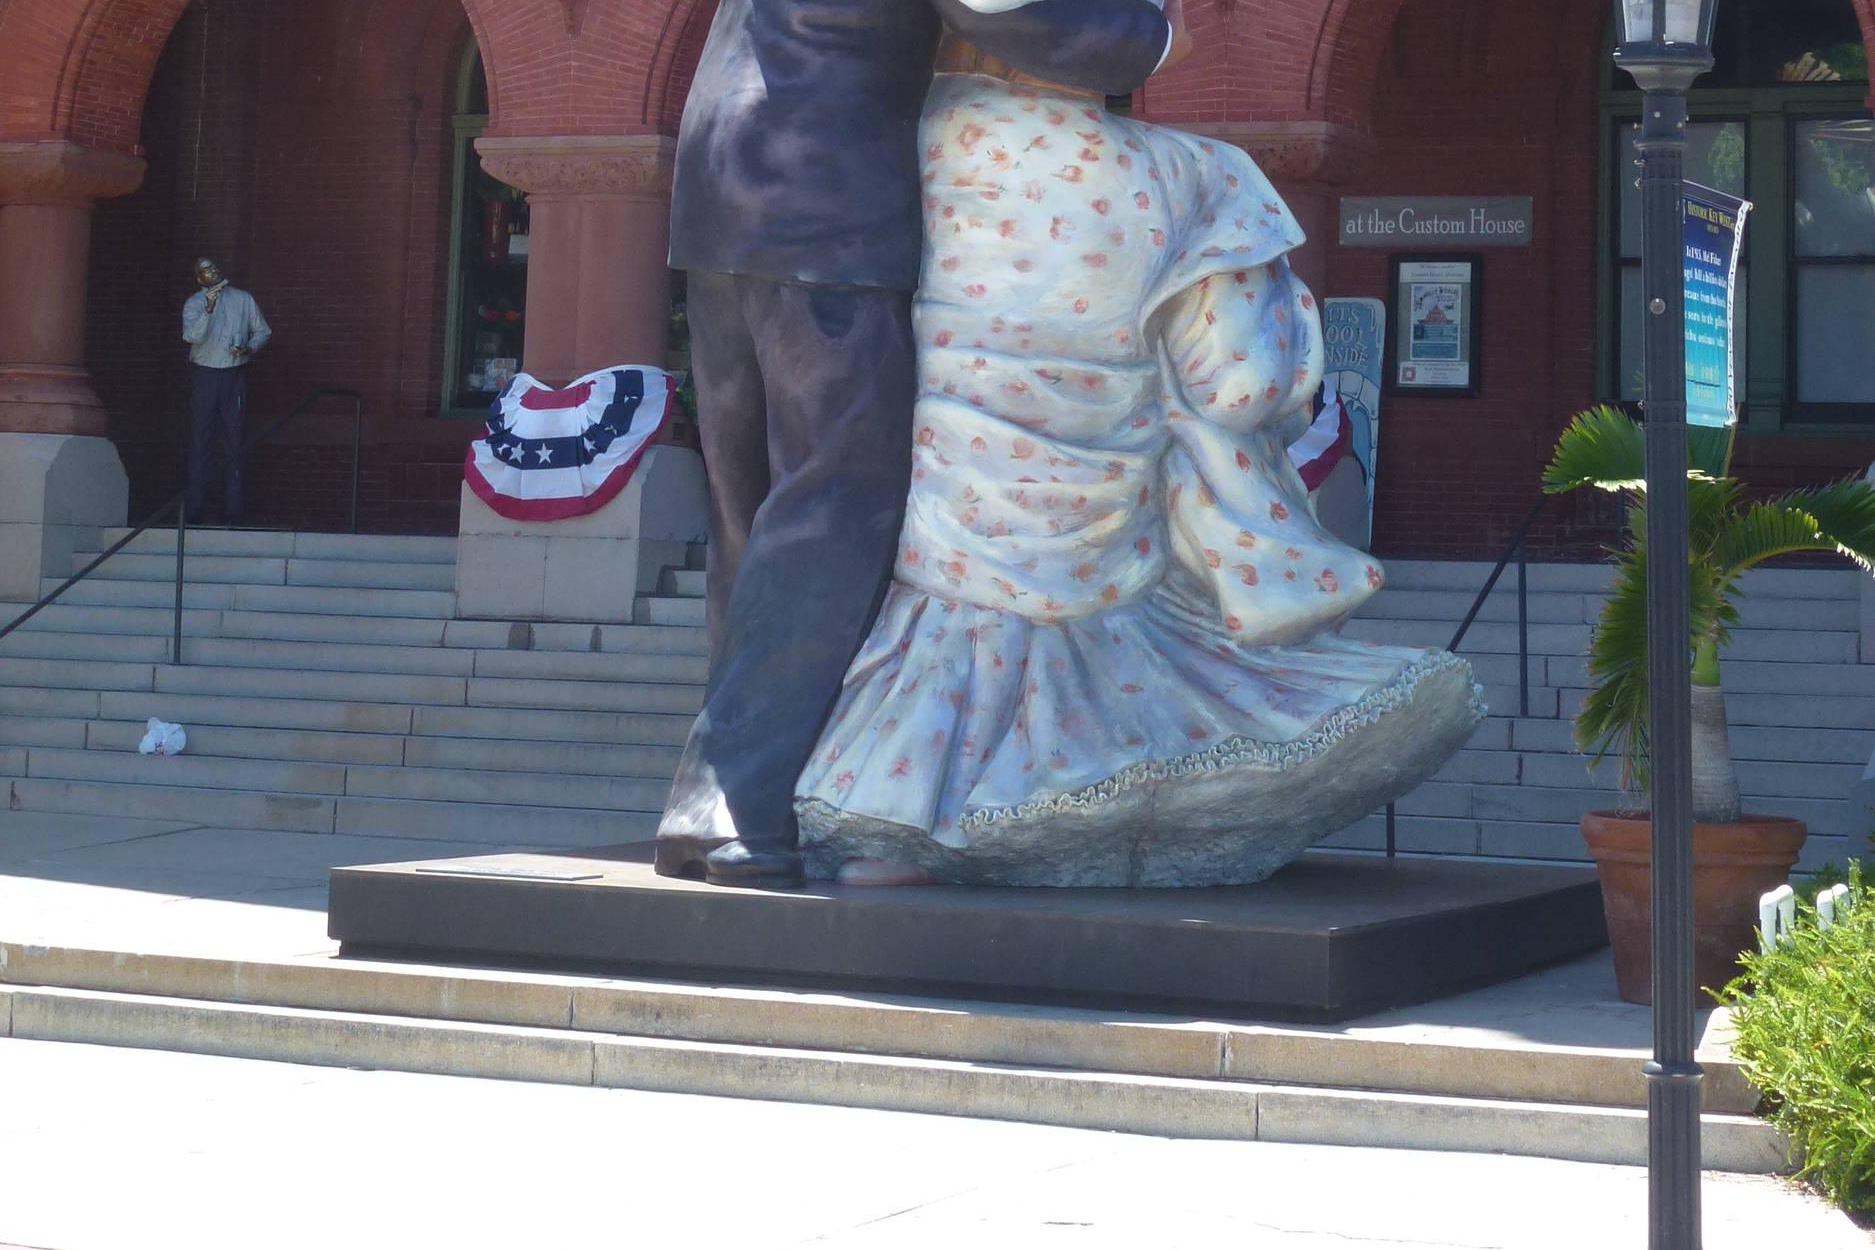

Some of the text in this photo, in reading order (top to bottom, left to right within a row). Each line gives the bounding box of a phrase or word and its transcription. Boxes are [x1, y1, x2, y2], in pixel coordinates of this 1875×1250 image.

[1345, 208, 1526, 235] at the Custom House
[1325, 325, 1368, 348] OOL
[1324, 346, 1369, 367] NSIDE
